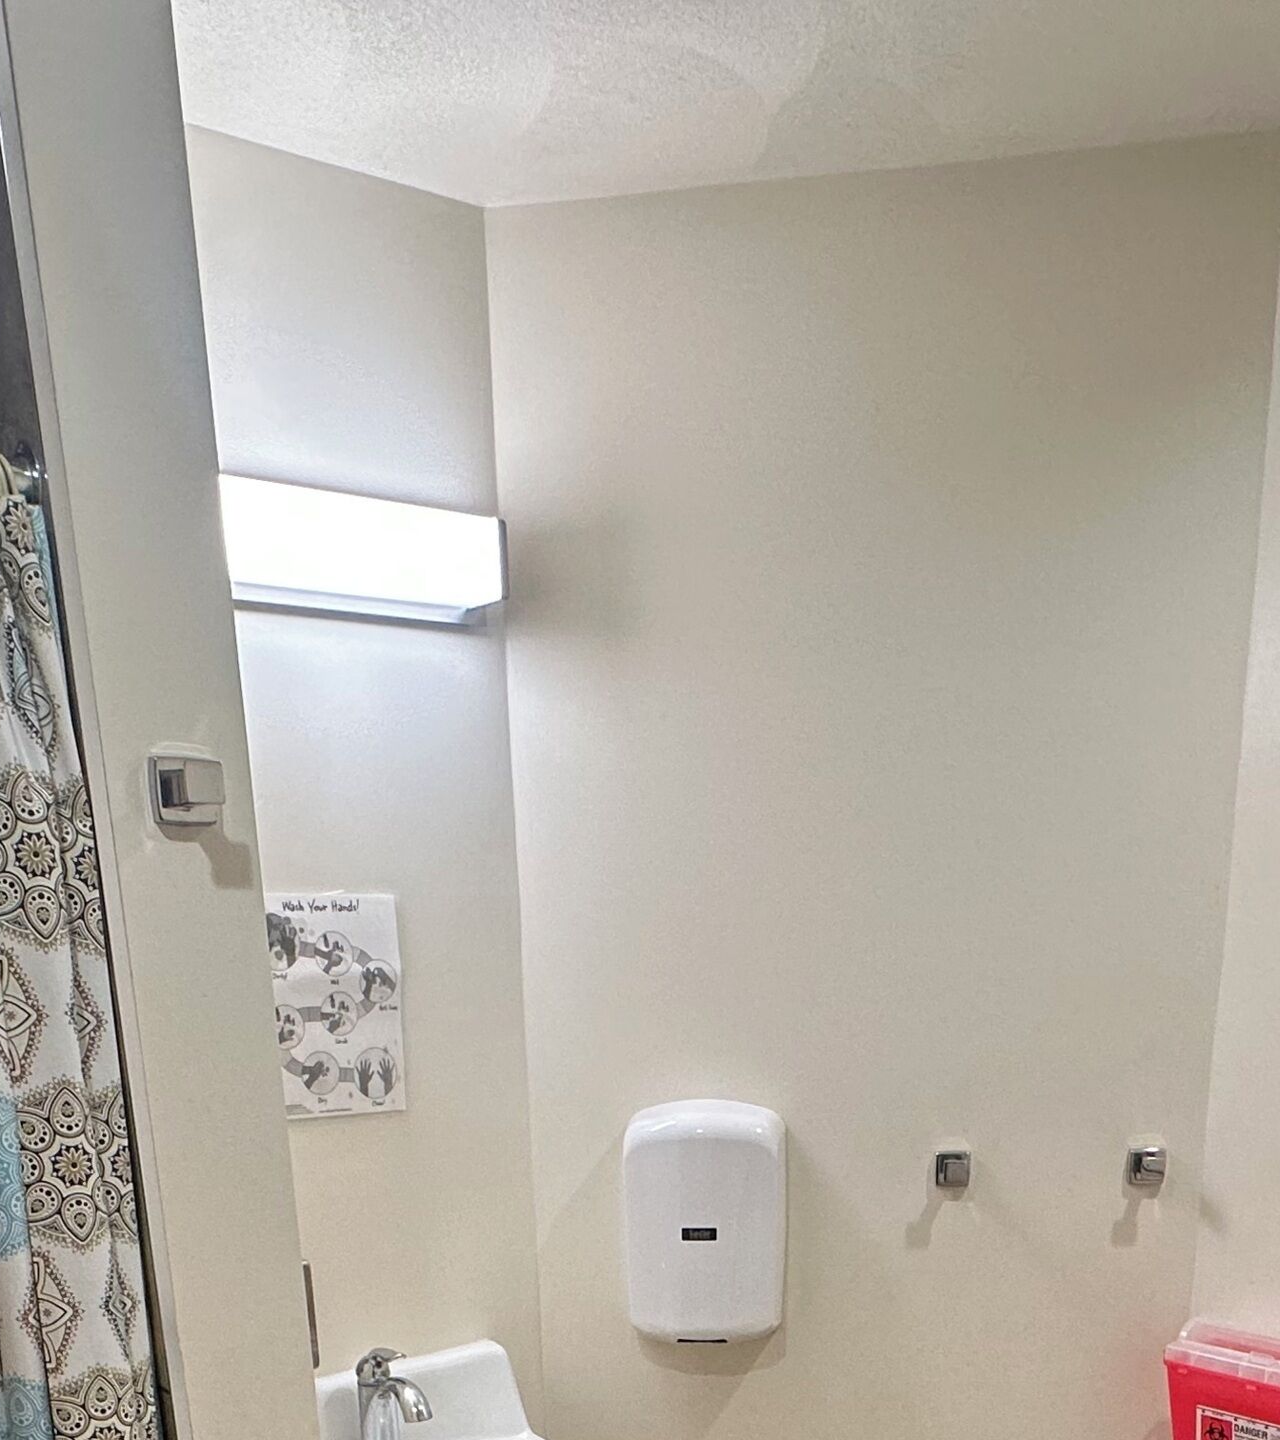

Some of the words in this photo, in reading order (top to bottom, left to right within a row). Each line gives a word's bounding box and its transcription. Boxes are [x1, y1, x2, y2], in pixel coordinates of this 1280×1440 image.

[282, 900, 305, 912] Wash
[307, 899, 328, 913] Your
[331, 899, 360, 913] Hands!
[1234, 1424, 1268, 1440] DANGER
